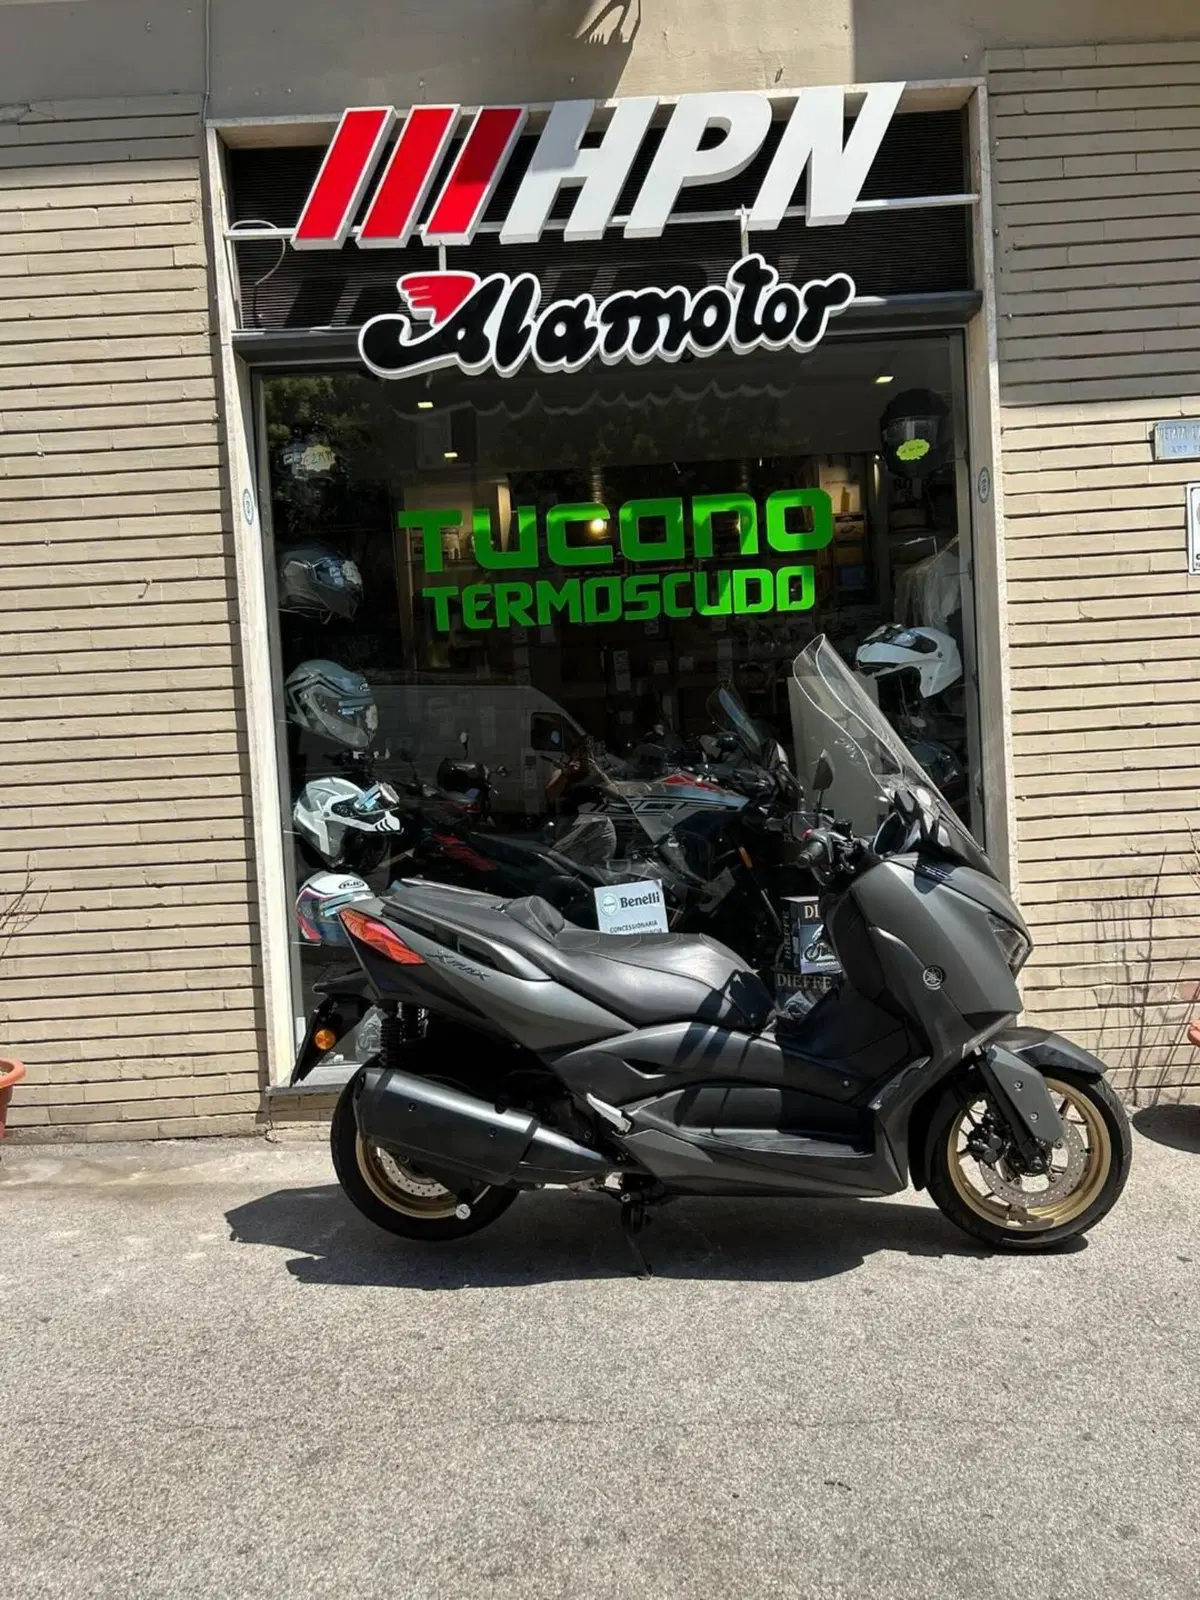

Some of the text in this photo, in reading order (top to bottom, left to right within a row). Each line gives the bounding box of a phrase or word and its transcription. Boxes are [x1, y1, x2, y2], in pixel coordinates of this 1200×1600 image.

[500, 81, 906, 245] HPN
[359, 253, 855, 378] Alamotor
[423, 565, 816, 632] TERMOSCUDO
[620, 891, 660, 908] Benelli
[610, 920, 658, 934] CONCESSIONARIA
[776, 974, 832, 990] DIEFFE
